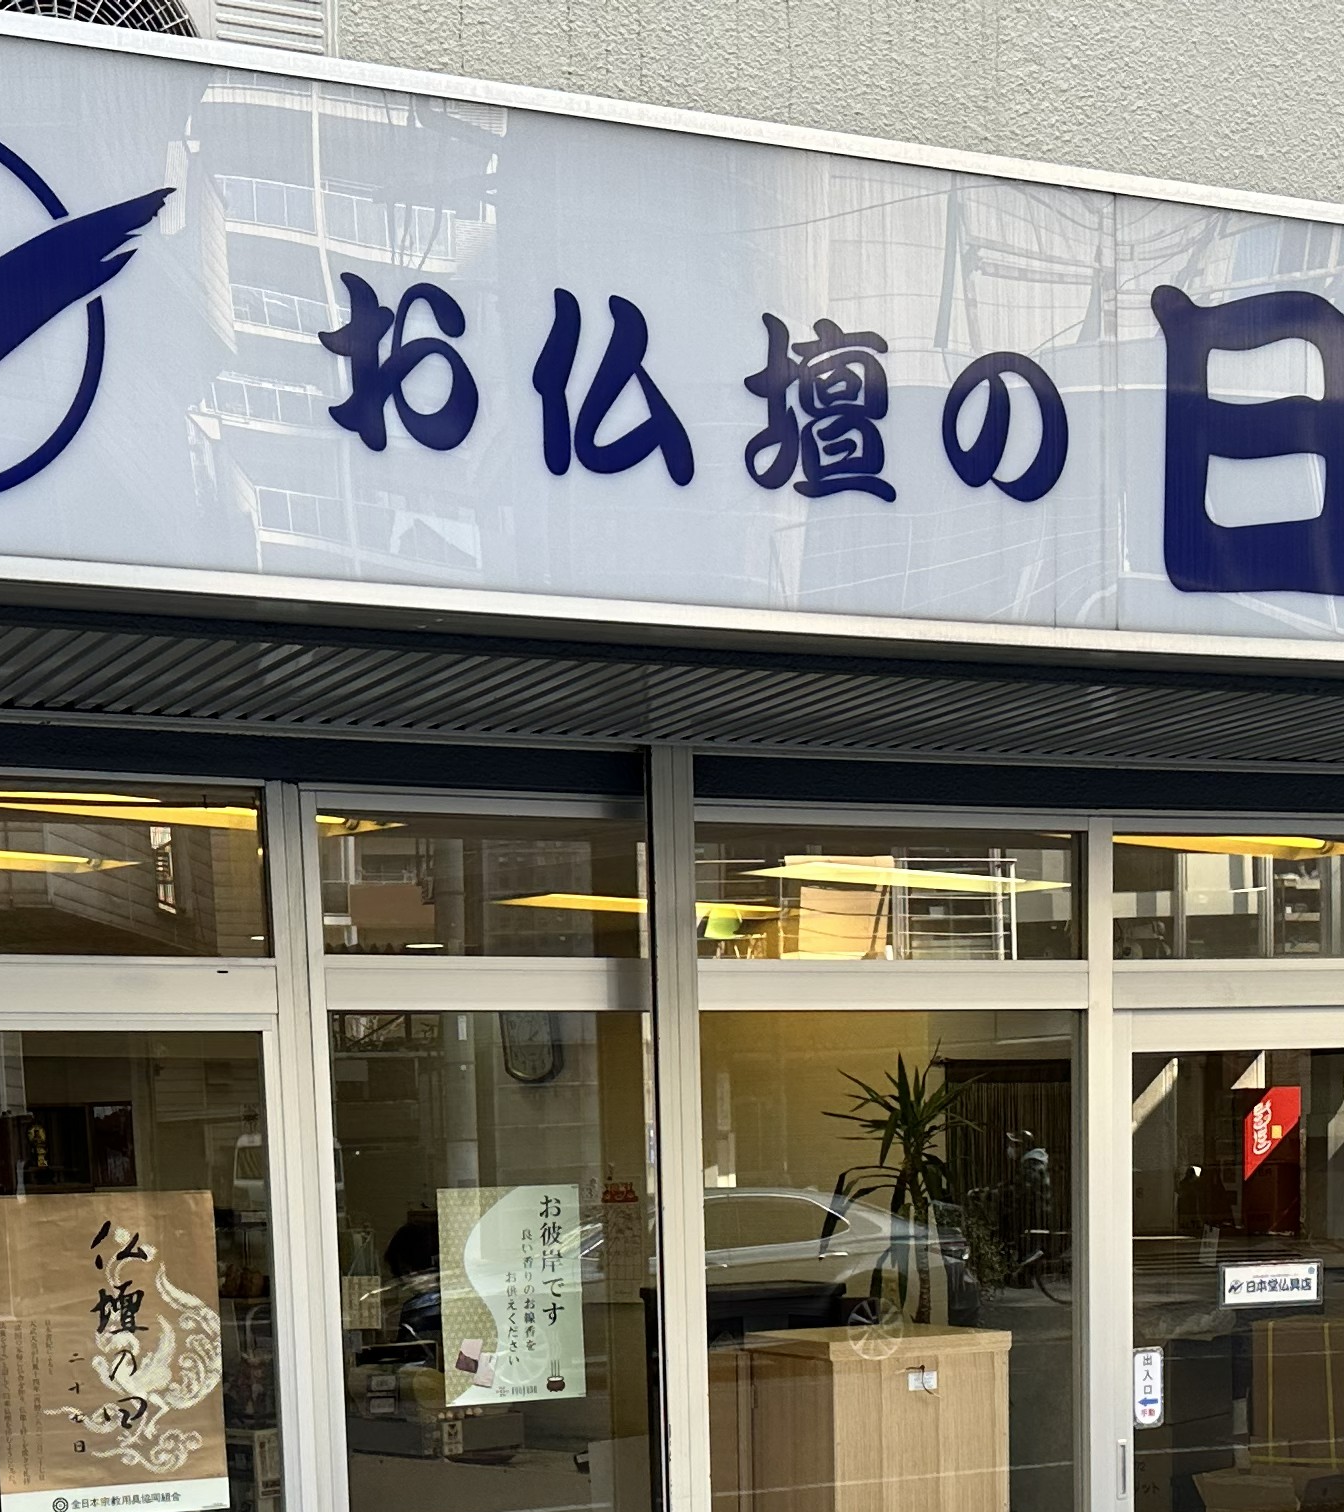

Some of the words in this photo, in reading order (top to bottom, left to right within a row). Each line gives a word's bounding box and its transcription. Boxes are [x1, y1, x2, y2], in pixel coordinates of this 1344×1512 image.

[539, 1195, 565, 1326] お彼岸です
[1246, 1278, 1312, 1293] 日本堂仏具店
[505, 1272, 521, 1366] お供えください
[1142, 1353, 1153, 1395] 出入口
[1141, 1408, 1156, 1417] 手動
